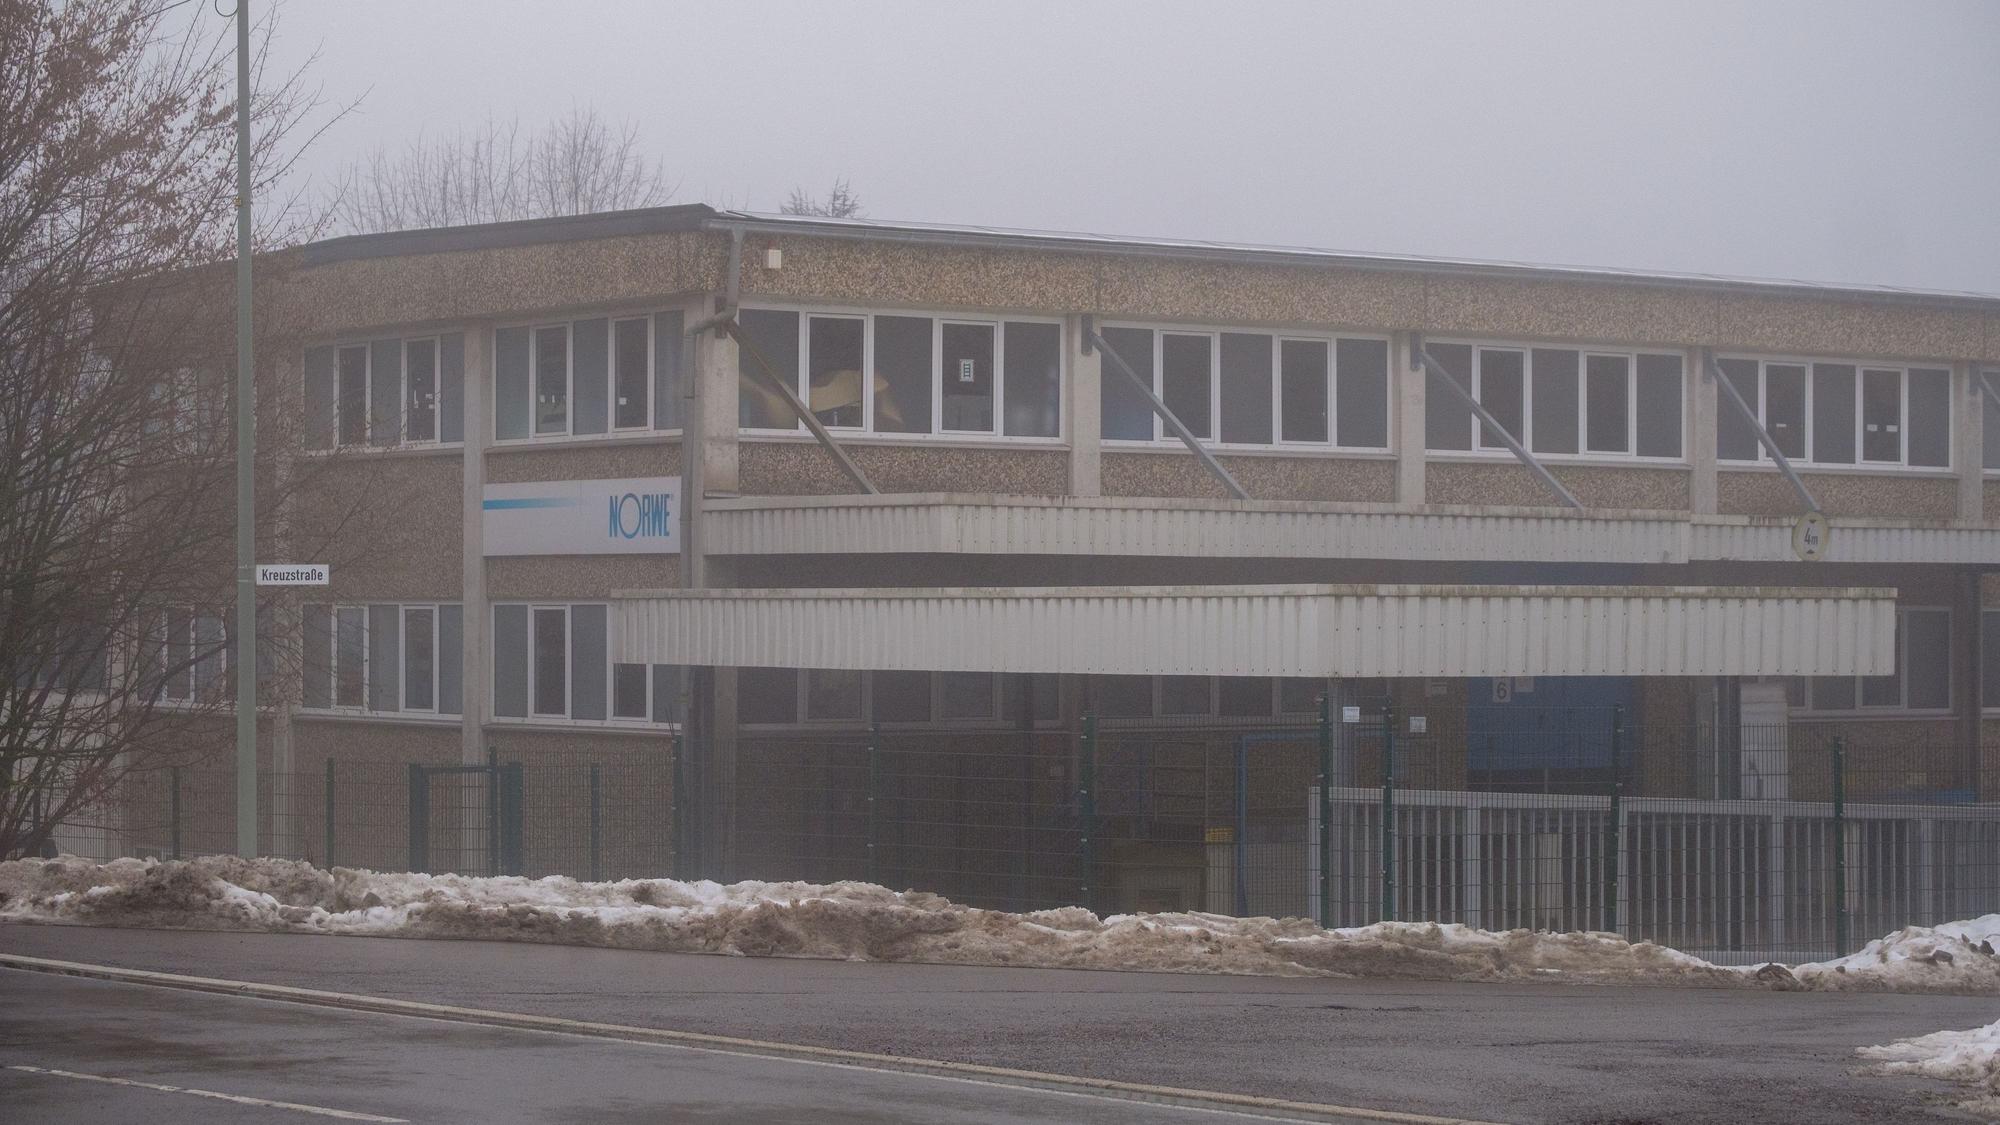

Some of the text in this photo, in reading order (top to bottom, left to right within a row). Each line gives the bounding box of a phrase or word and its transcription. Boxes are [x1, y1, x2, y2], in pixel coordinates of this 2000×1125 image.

[609, 493, 670, 539] NORWE
[262, 568, 323, 581] Kreuzstraße
[1497, 681, 1507, 700] 6
